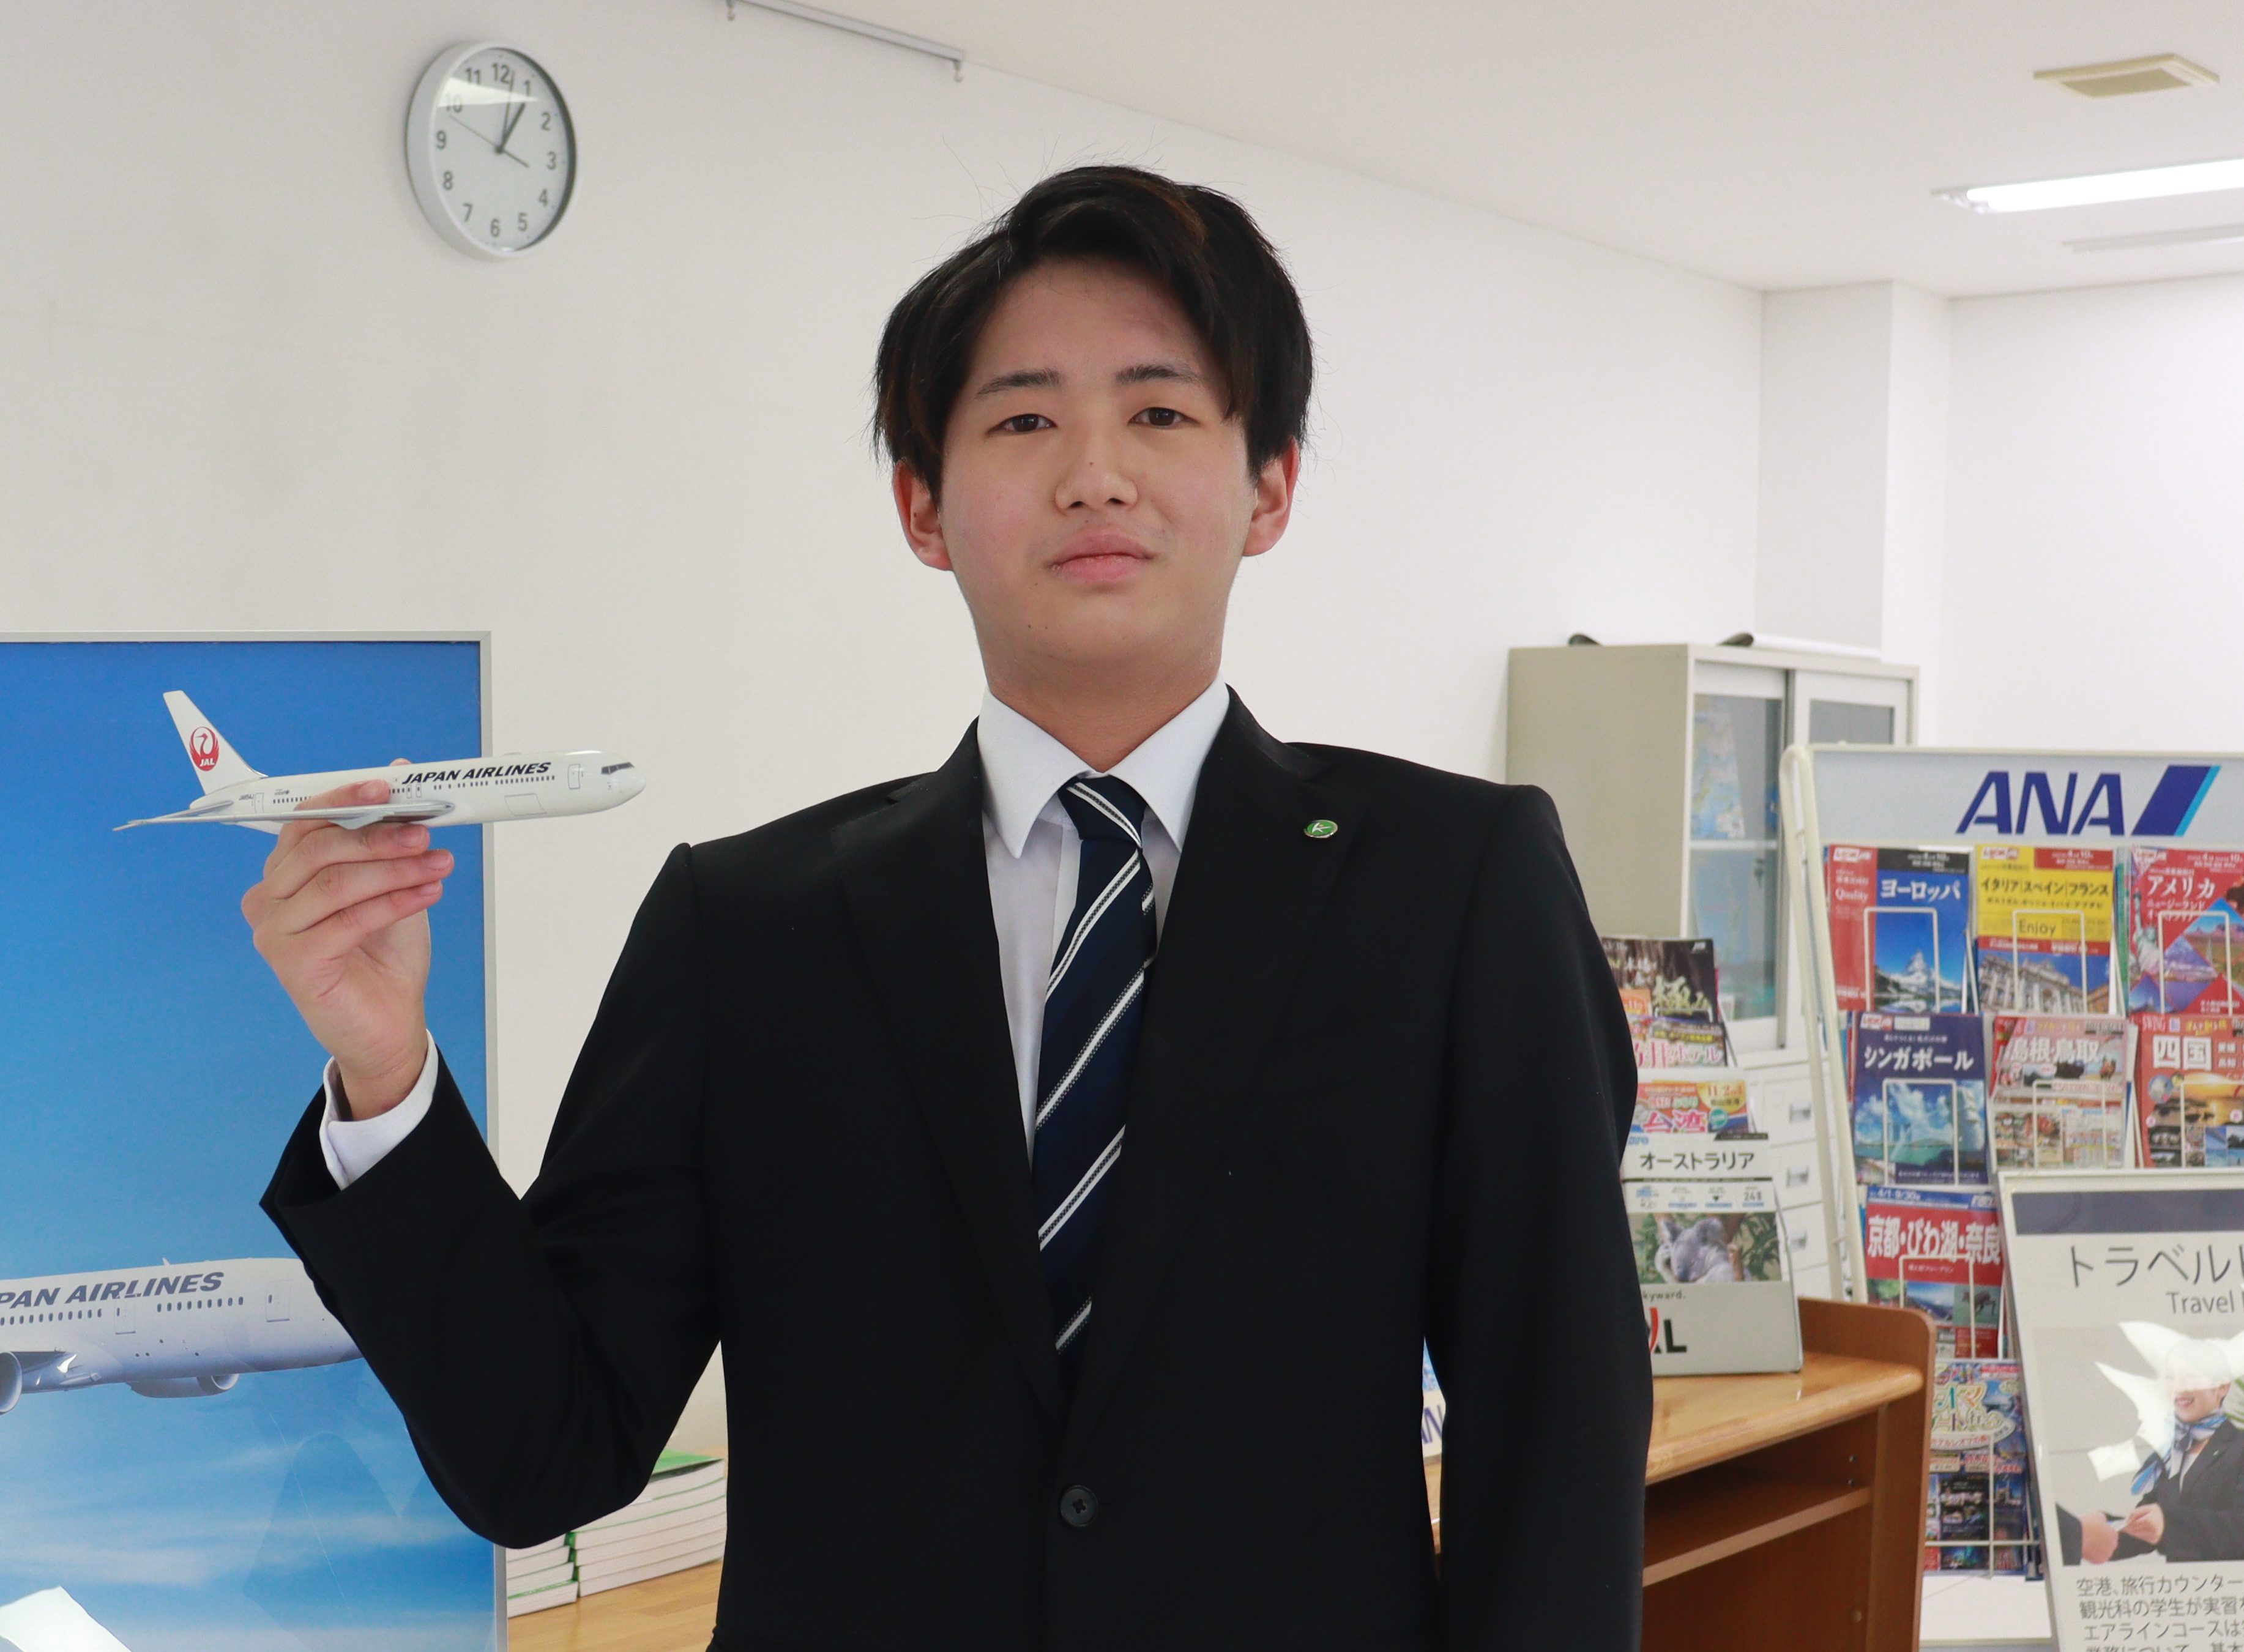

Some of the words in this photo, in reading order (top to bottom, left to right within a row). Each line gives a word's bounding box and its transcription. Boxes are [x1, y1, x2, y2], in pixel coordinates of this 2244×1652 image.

[466, 67, 481, 85] 11
[491, 62, 510, 84] 12
[524, 80, 531, 97] 1
[541, 111, 550, 131] 2
[436, 130, 446, 150] 9
[547, 152, 556, 171] 3
[442, 171, 453, 191] 8
[539, 189, 548, 207] 4
[463, 203, 473, 222] 7
[518, 212, 528, 232] 5
[490, 218, 501, 238] 6
[199, 758, 215, 767] JAL
[401, 769, 461, 784] JAPAN
[462, 762, 551, 780] AIRLINES
[1955, 770, 2125, 836] ANA
[1880, 878, 1962, 902] ヨーロッパ
[1981, 877, 2019, 893] イタリア
[2022, 880, 2064, 895] スペイン
[2070, 880, 2109, 896] フランス
[2147, 875, 2216, 901] アメリカ
[2019, 920, 2057, 936] Enjoy
[1864, 1045, 1975, 1072] シンガポール
[2008, 1037, 2100, 1065] 島根・鳥取
[2153, 1035, 2213, 1071] 四国
[1639, 1152, 1754, 1170] オーストラリア
[1867, 1215, 2001, 1265] 京都・びわ湖・奈良
[2071, 1243, 2244, 1288] トラベル
[64, 1271, 225, 1304] AIRLINES
[1642, 1289, 1686, 1302] kyward.
[2166, 1289, 2235, 1315] Travel
[2076, 1573, 2243, 1598] 空港、旅行カウンター
[2084, 1620, 2244, 1642] エアラインコースは
